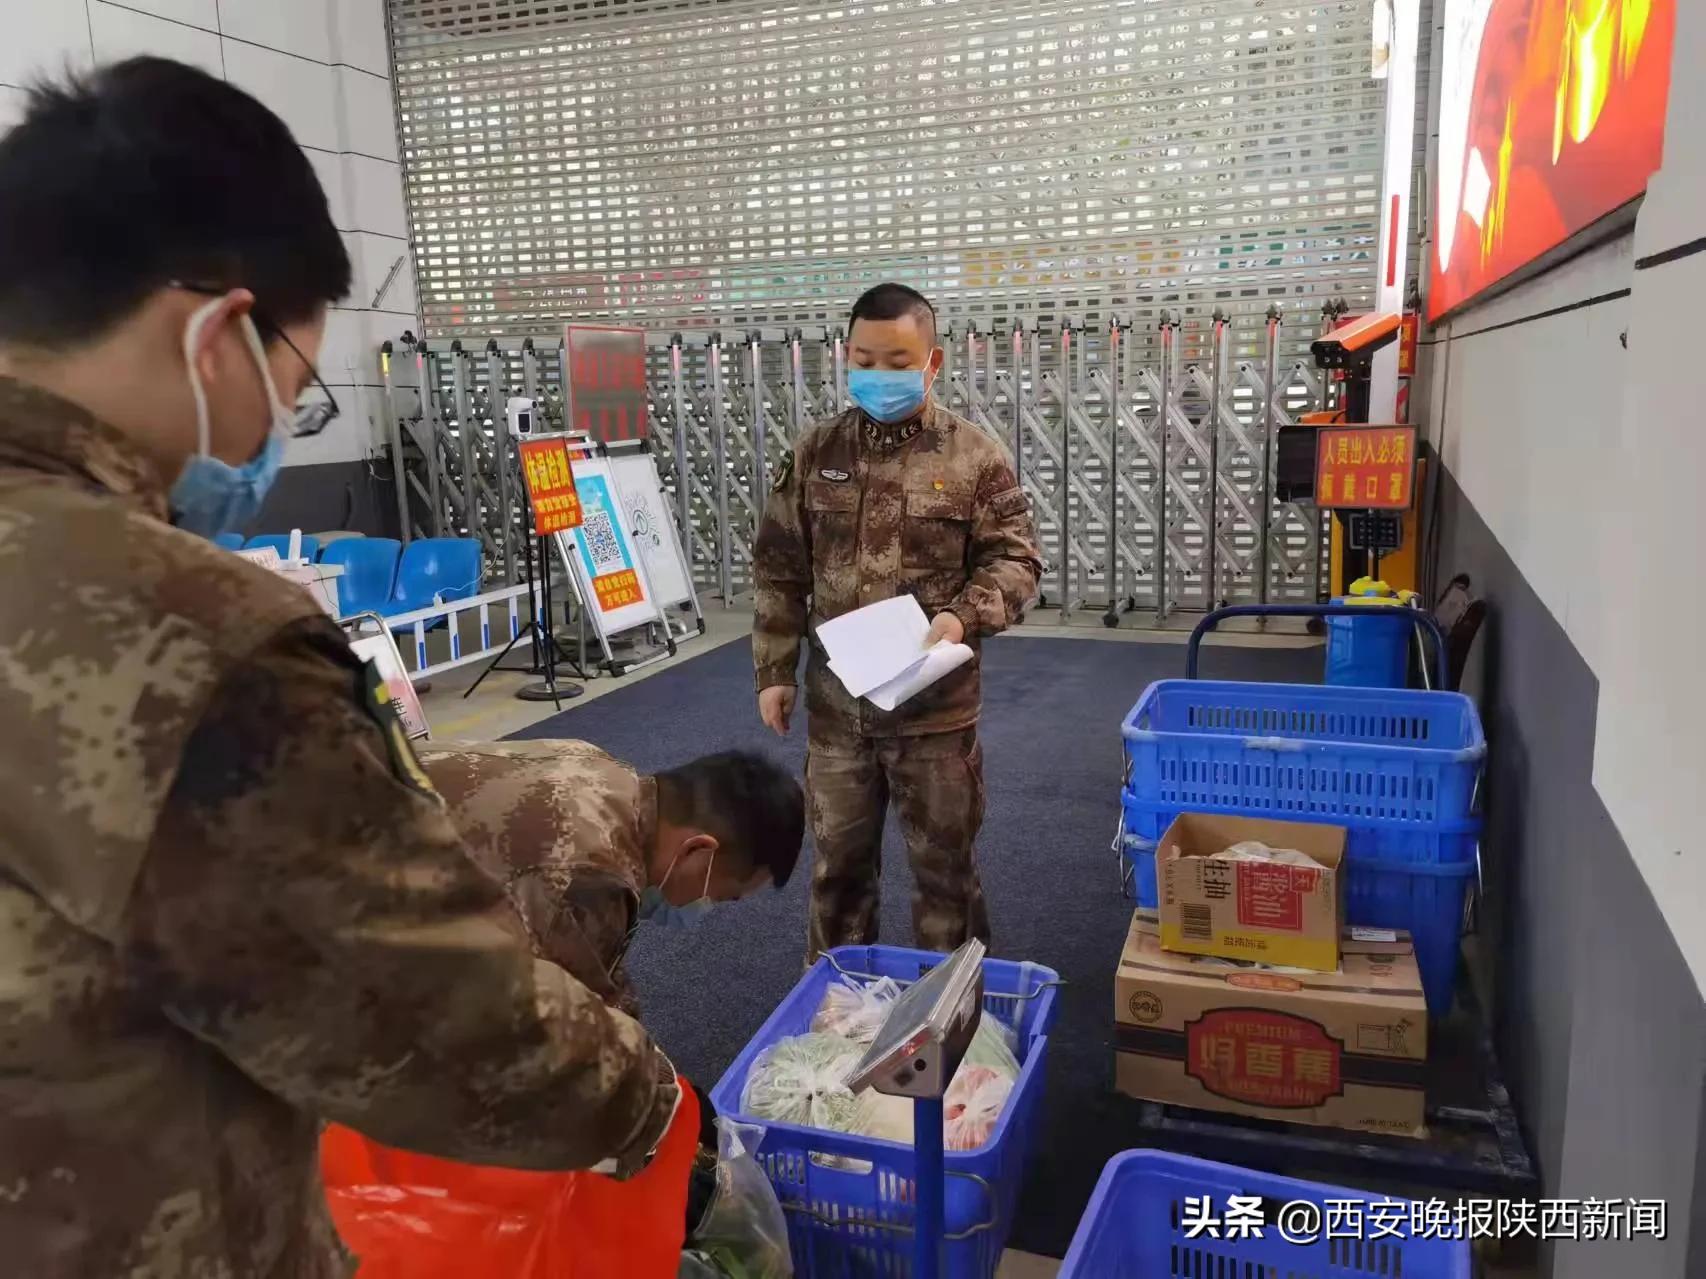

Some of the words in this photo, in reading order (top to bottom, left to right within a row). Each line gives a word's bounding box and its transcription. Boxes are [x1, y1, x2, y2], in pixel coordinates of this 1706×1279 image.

[1322, 433, 1406, 465] 人员出入必须
[1203, 859, 1232, 900] 生抽
